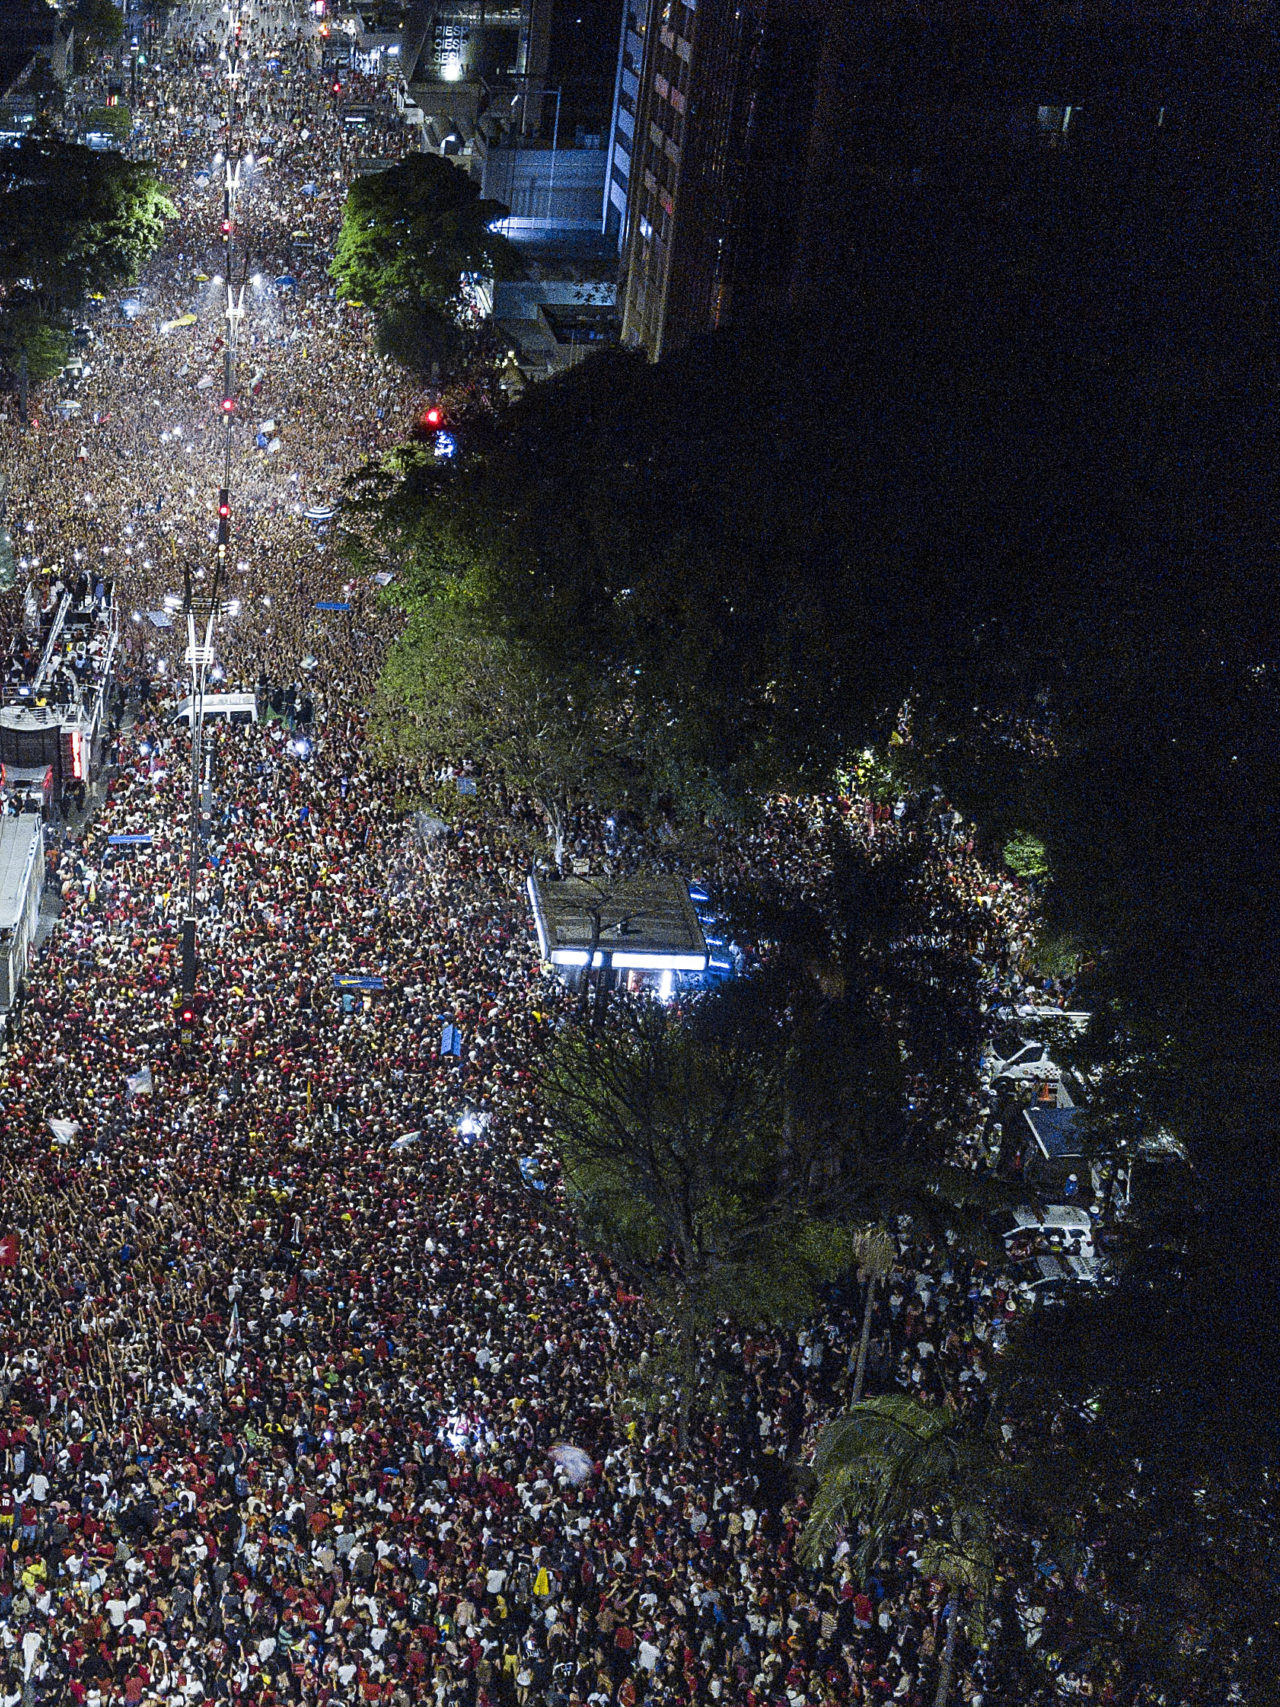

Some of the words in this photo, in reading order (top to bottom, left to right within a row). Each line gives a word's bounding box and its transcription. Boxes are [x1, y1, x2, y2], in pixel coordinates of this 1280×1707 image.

[435, 26, 469, 36] FIESP
[434, 39, 468, 49] CIESP
[433, 52, 459, 63] SESI
[2, 1498, 10, 1507] 10
